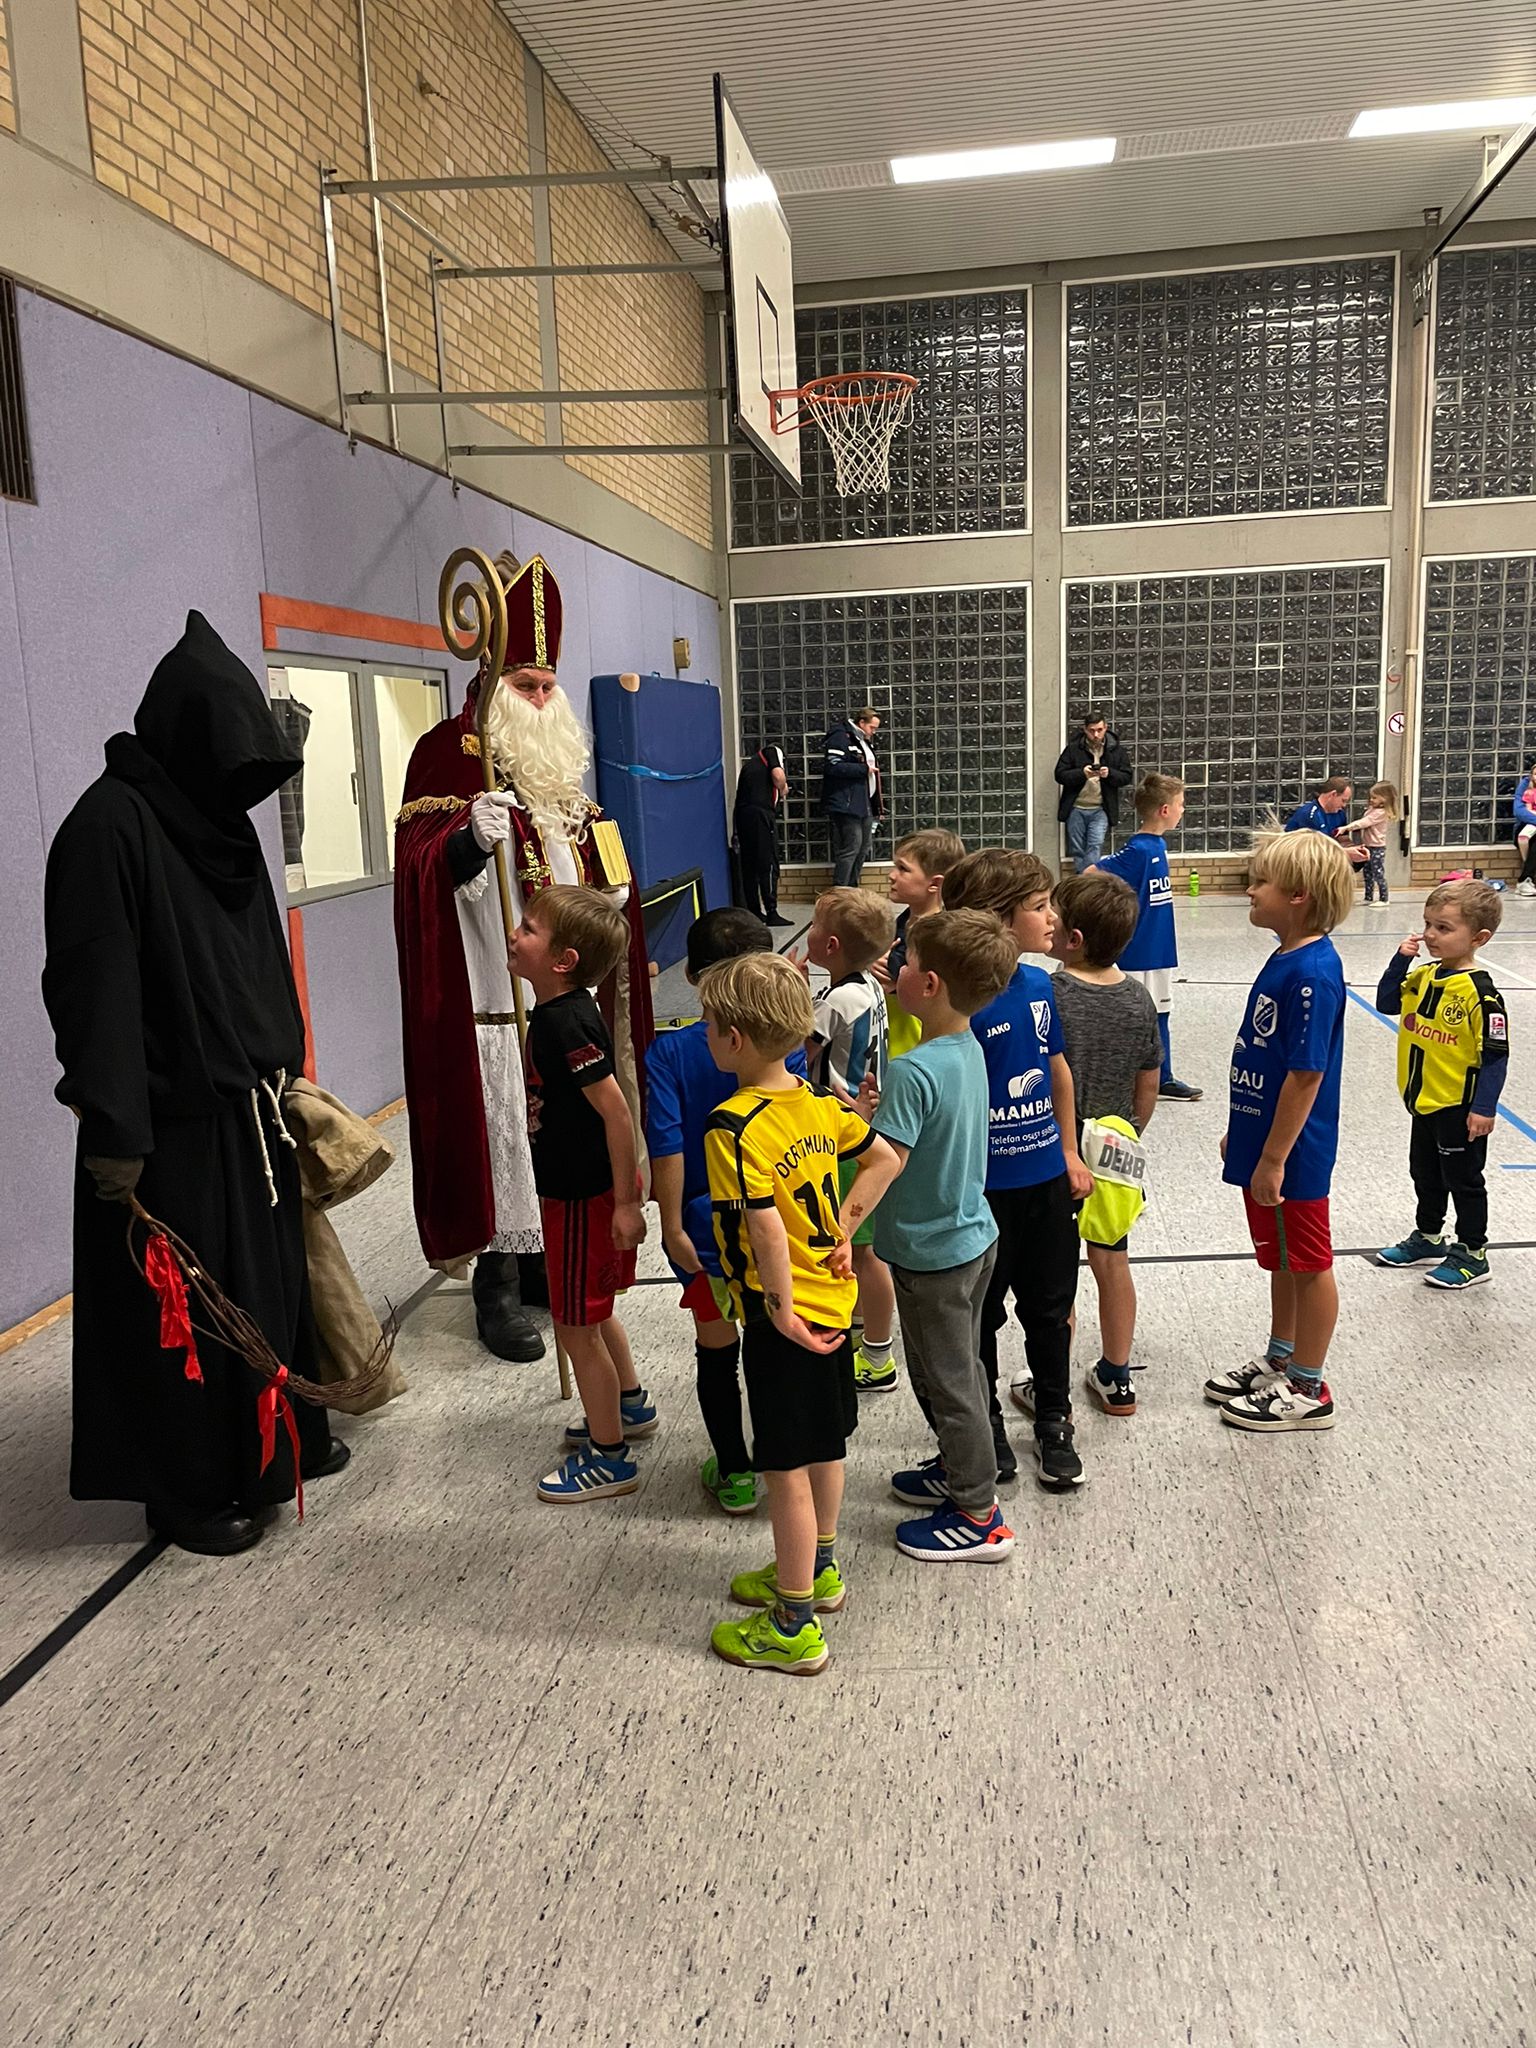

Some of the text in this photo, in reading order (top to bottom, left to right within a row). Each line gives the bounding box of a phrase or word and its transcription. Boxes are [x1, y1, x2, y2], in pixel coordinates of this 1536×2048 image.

[1445, 1002, 1464, 1020] BVB
[987, 1022, 1011, 1038] JAKO
[990, 1134, 1020, 1145] Telefon
[794, 1172, 840, 1249] 11
